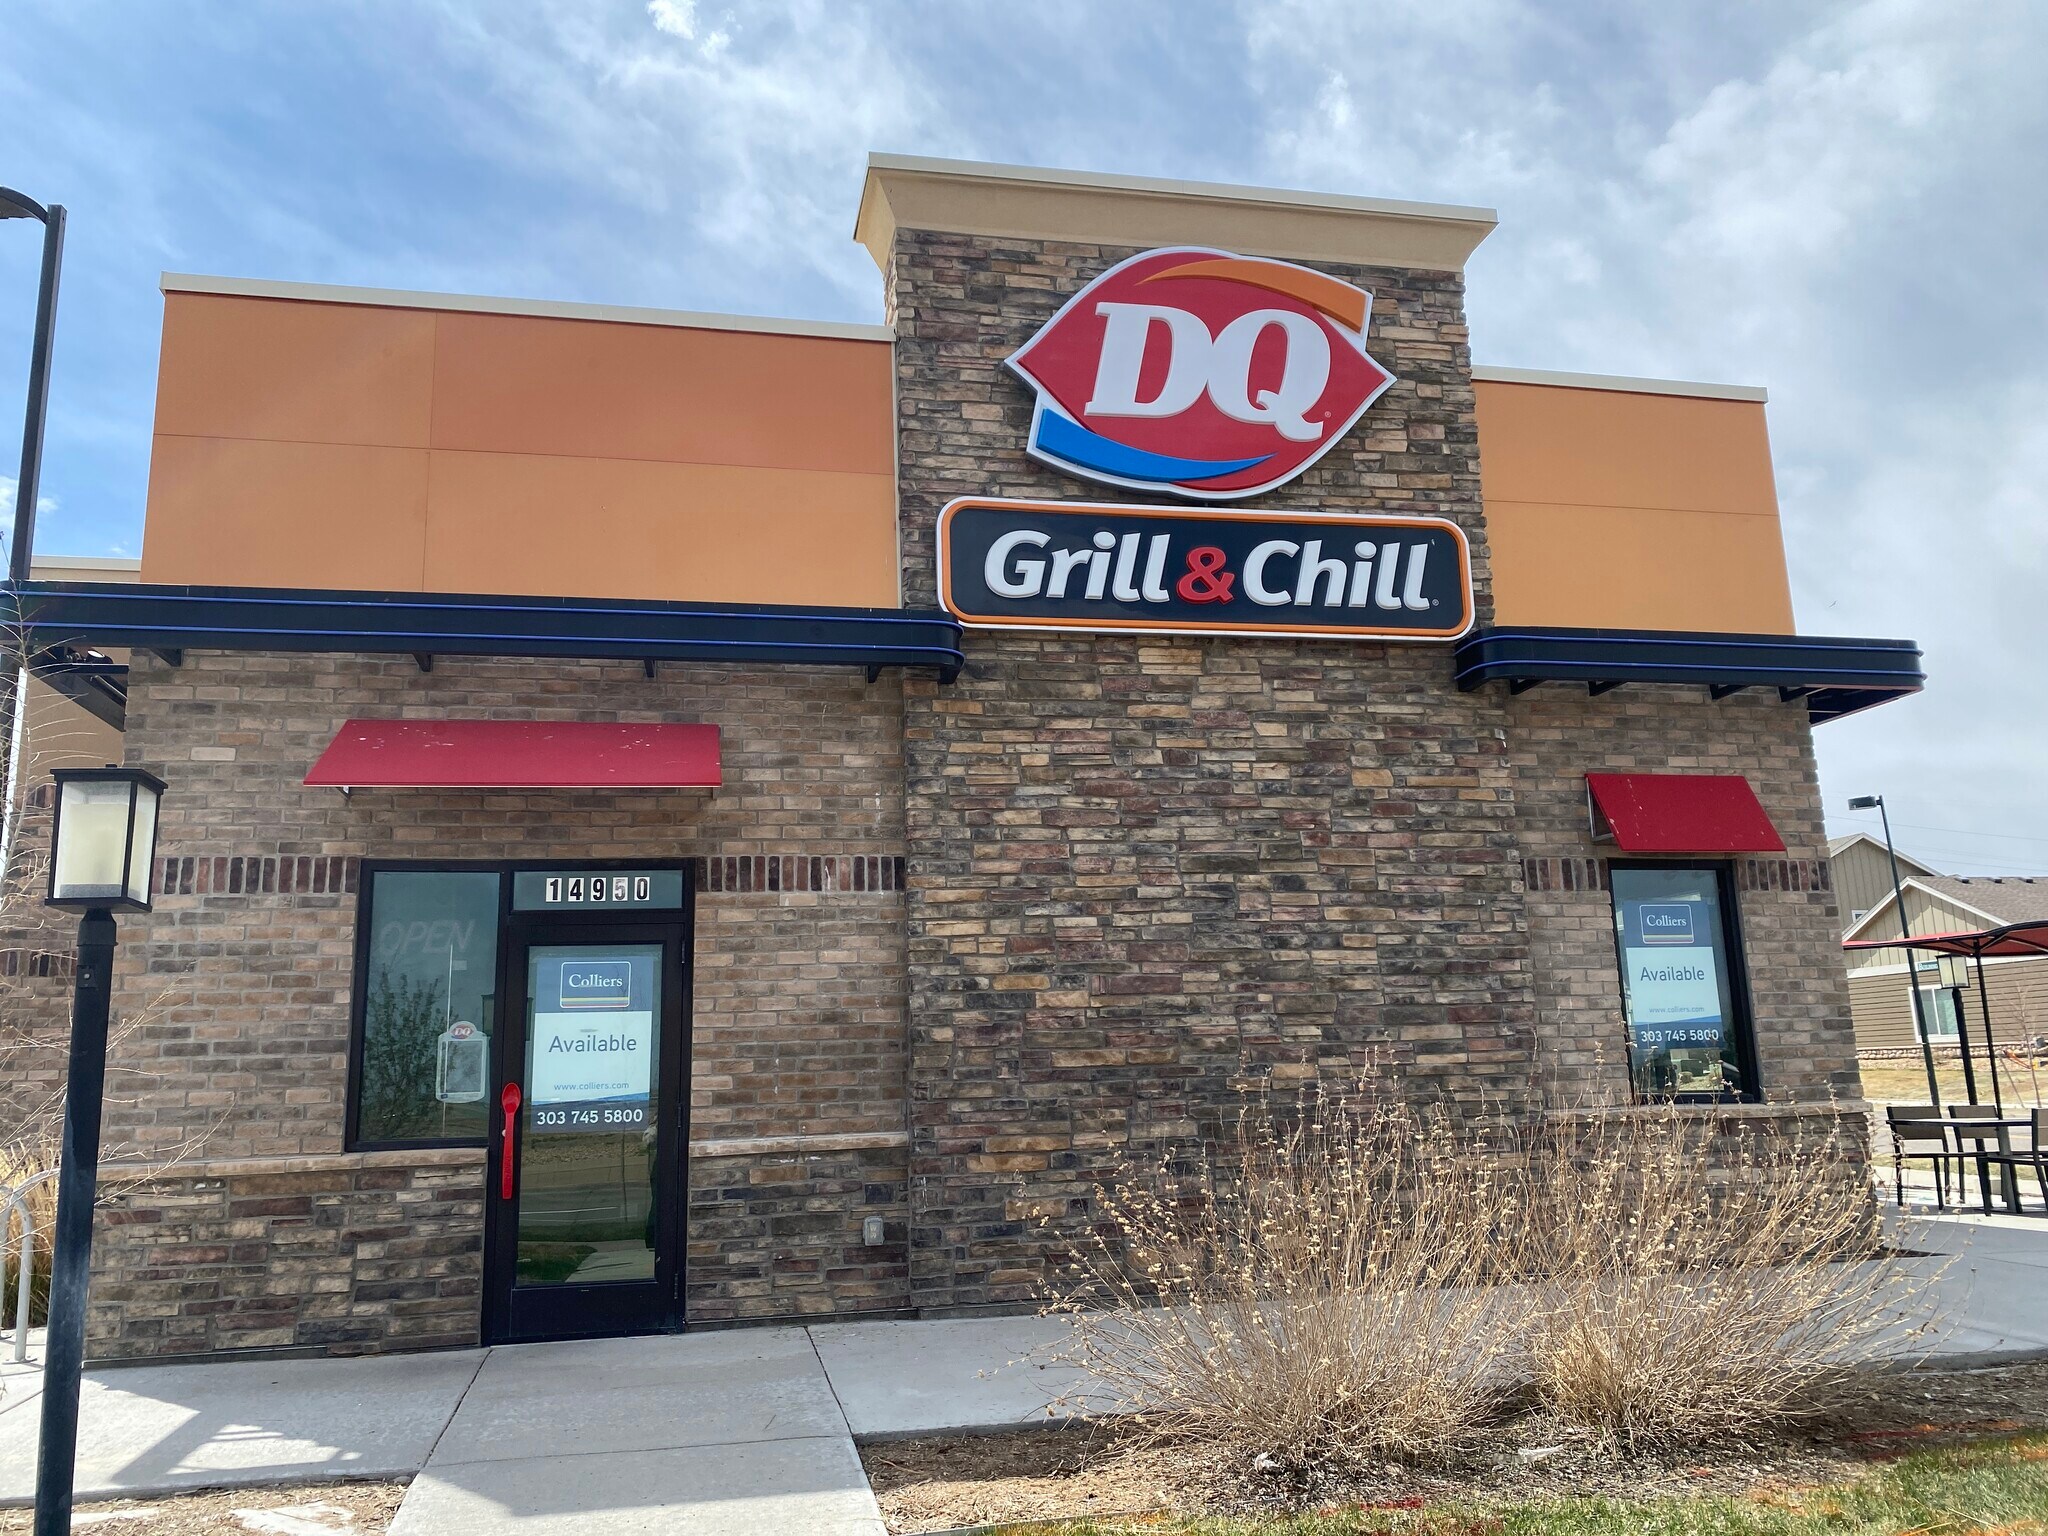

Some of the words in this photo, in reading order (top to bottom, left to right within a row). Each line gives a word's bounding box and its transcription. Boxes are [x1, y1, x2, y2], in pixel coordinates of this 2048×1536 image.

[1084, 302, 1330, 442] DQ
[985, 529, 1171, 603] Grill
[1176, 547, 1235, 604] &
[1243, 540, 1430, 611] Chill
[548, 878, 649, 901] 14950
[1647, 914, 1687, 927] Colliers
[379, 920, 475, 954] OPEN
[568, 973, 623, 988] Colliers
[1640, 966, 1705, 981] Available
[1649, 1005, 1704, 1014] www.colliers.com
[454, 1027, 471, 1037] DQ
[1640, 1029, 1663, 1042] 303
[1666, 1029, 1687, 1041] 745
[1690, 1028, 1719, 1041] 5800
[549, 1034, 637, 1054] Available
[554, 1081, 629, 1091] www.colliers.com
[536, 1110, 566, 1125] 303
[571, 1109, 599, 1124] 745
[603, 1108, 643, 1123] 5800
